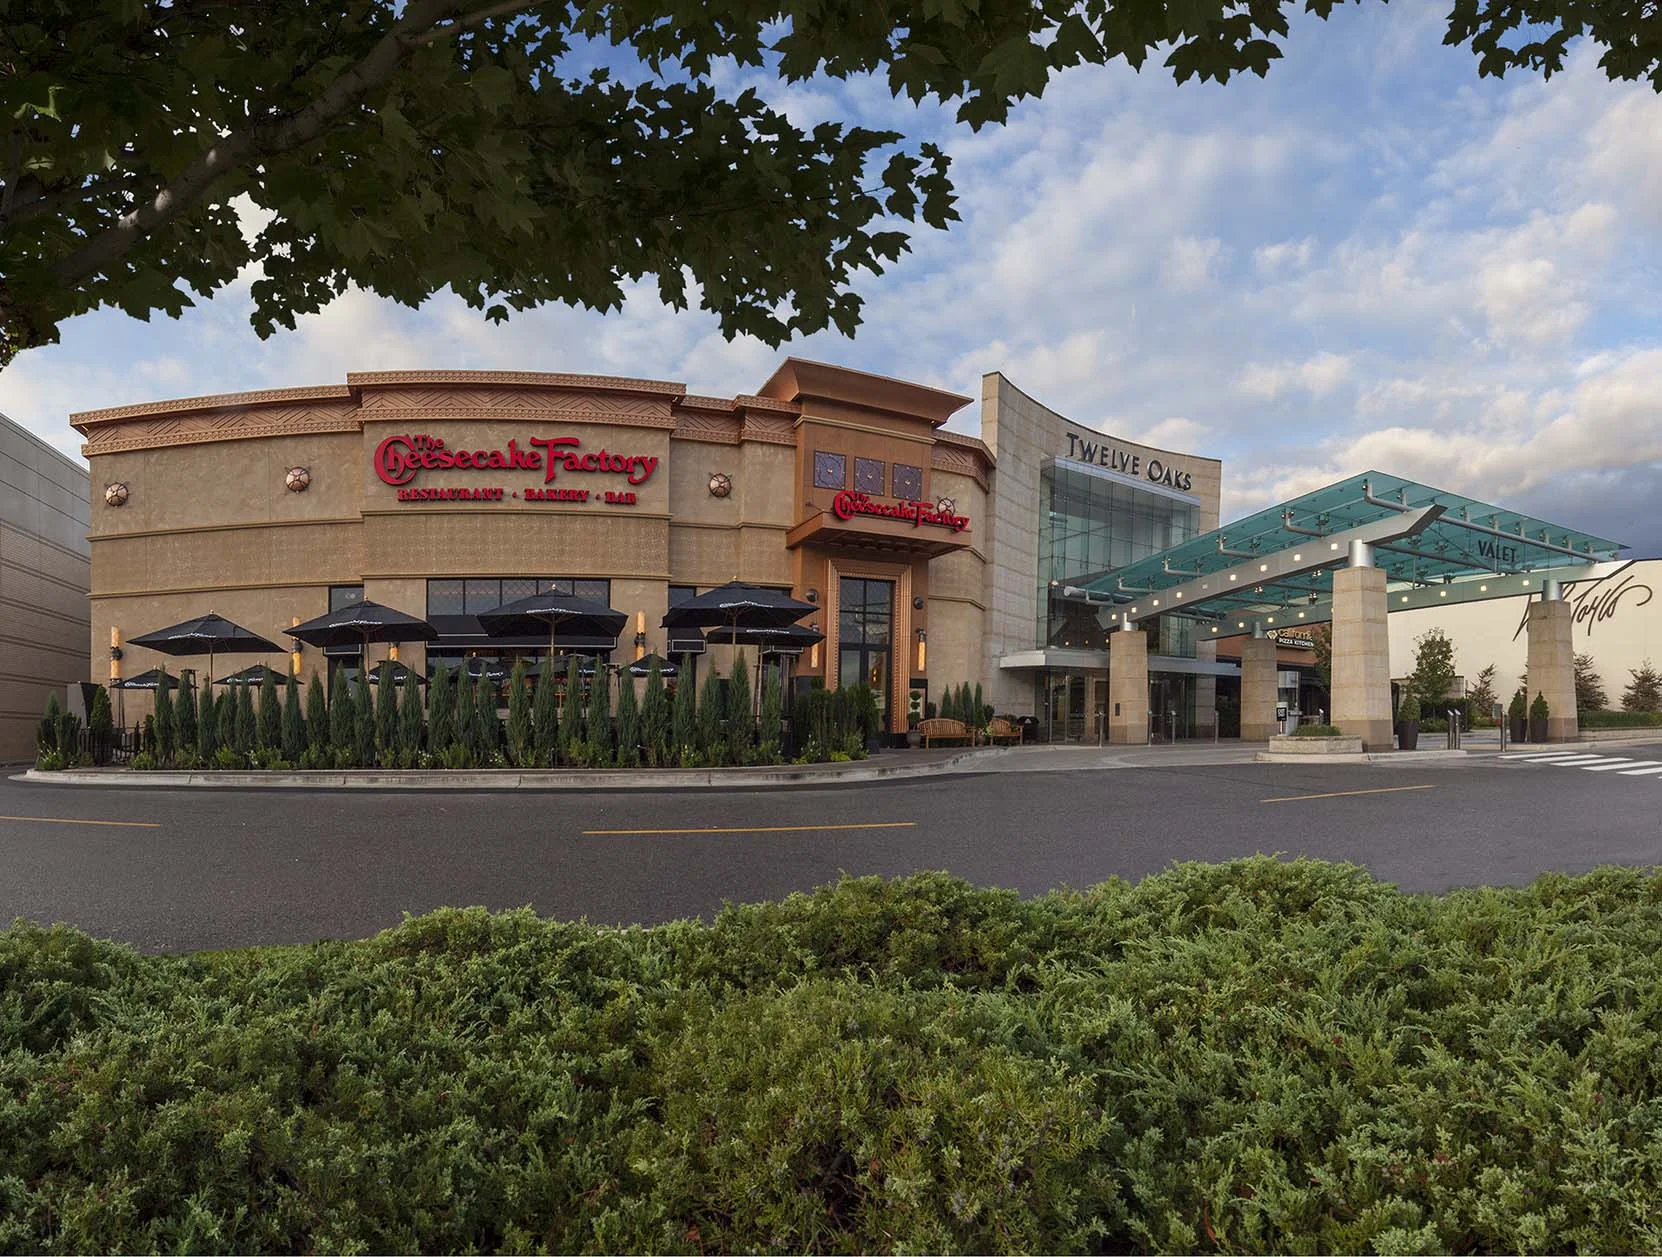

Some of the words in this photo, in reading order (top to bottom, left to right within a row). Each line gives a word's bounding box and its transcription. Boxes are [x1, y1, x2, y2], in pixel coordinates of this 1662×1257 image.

[414, 434, 444, 449] The
[373, 434, 541, 486] Cheesecake
[530, 436, 658, 485] Factory
[1066, 432, 1139, 475] TWELVE
[1147, 459, 1192, 490] OAKS
[397, 488, 503, 501] RESTAURANT
[524, 488, 589, 502] BAKERY
[604, 491, 637, 505] BAR
[834, 490, 917, 521] Cheesecake
[909, 501, 970, 532] Factory
[1478, 539, 1517, 563] VALET
[1278, 637, 1294, 645] PIZZA
[1294, 640, 1315, 648] KITCHEN
